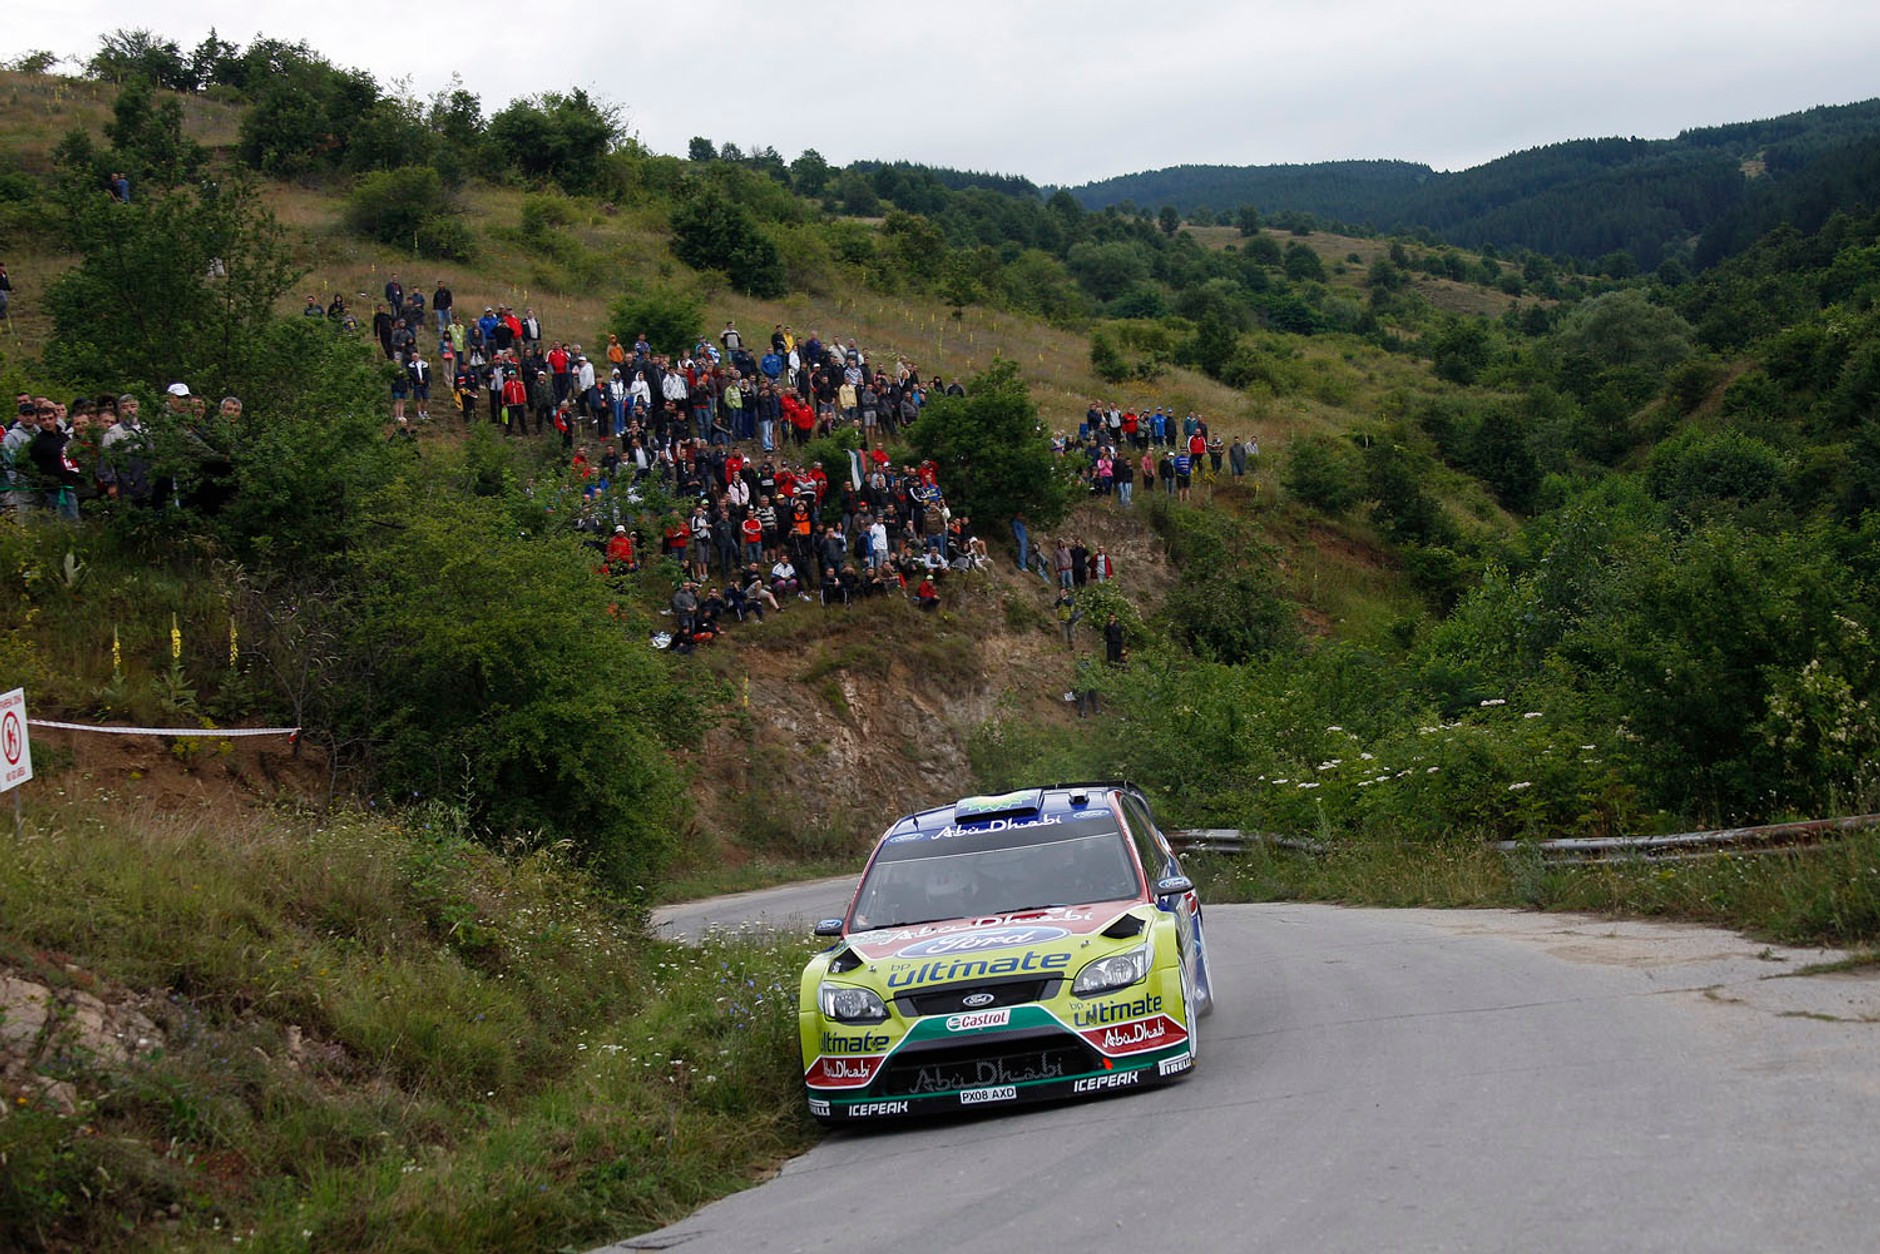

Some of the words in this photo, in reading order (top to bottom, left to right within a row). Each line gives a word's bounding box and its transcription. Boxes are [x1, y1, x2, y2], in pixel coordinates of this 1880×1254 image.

[926, 929, 1036, 954] Ford
[888, 951, 1072, 988] ultimate
[891, 964, 911, 972] bp
[962, 1011, 1007, 1028] Castrol
[1074, 992, 1162, 1027] ultimate
[821, 1031, 889, 1053] ltimate
[1073, 1071, 1139, 1092] ICEPEAK
[962, 1090, 988, 1102] PX08
[992, 1087, 1015, 1099] AXD
[848, 1101, 909, 1117] ICEPEAK
